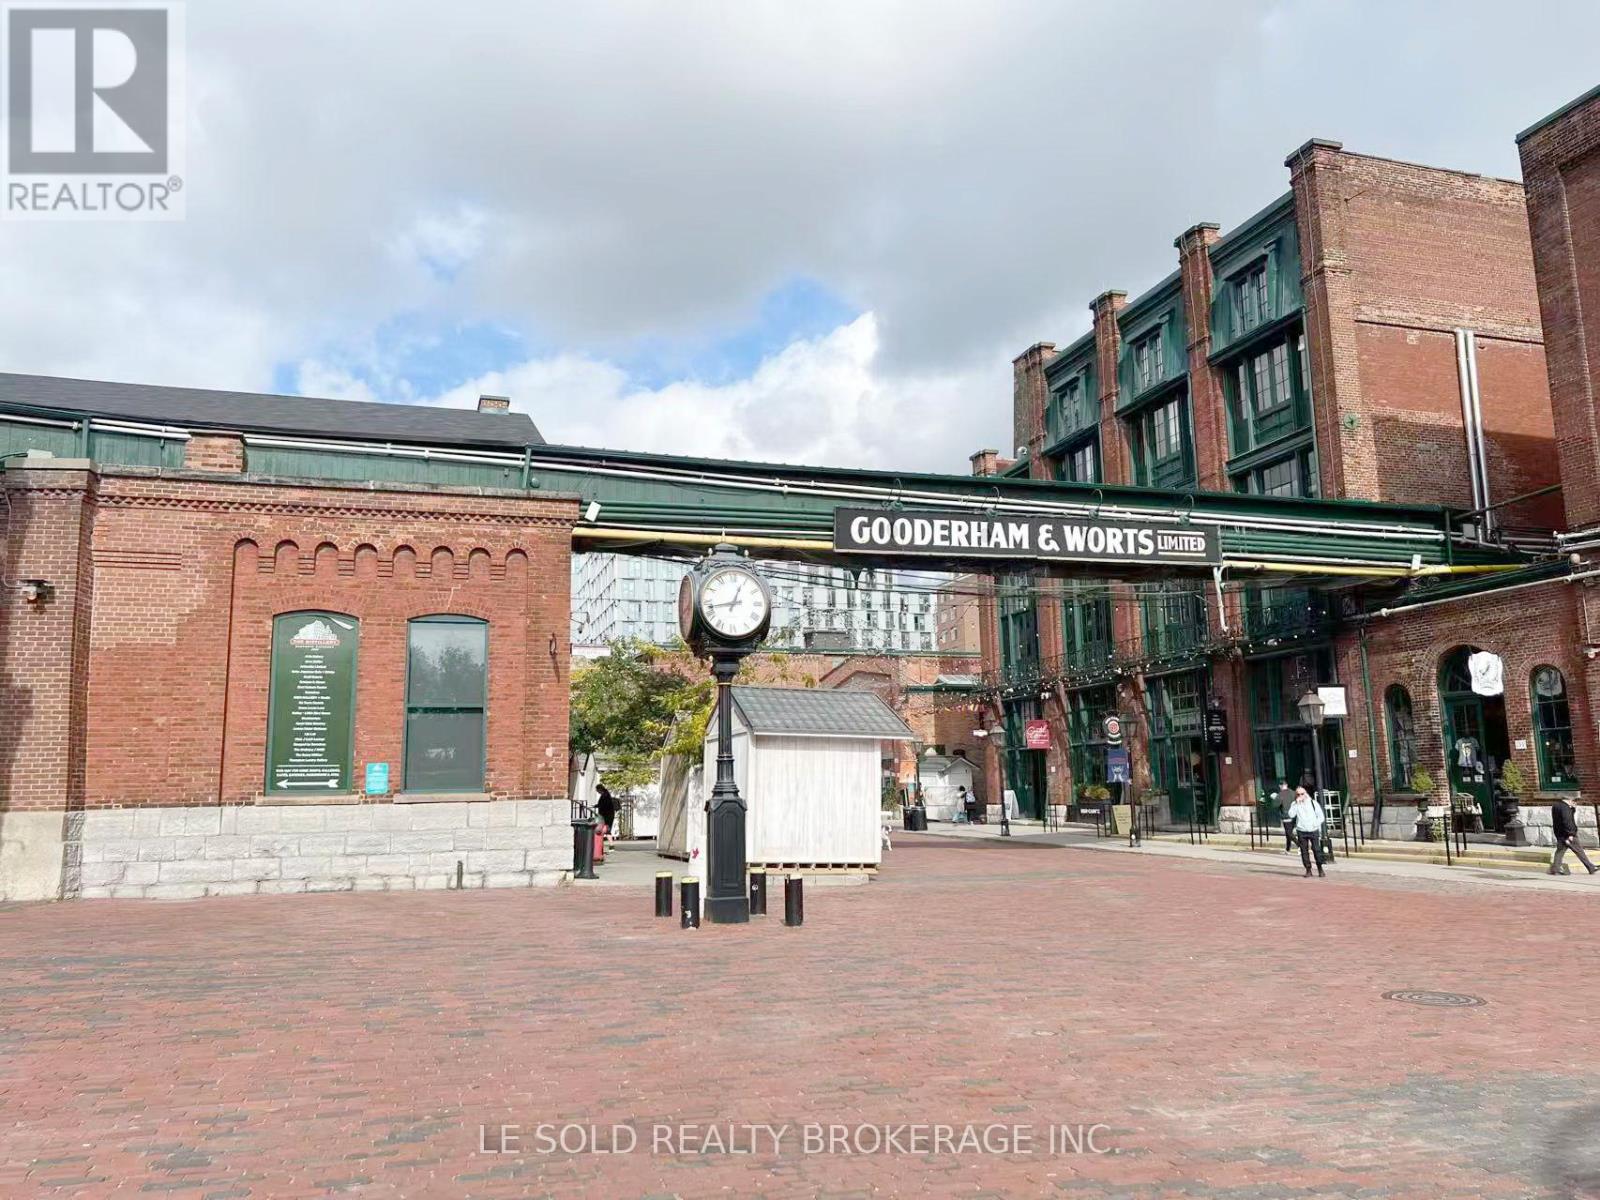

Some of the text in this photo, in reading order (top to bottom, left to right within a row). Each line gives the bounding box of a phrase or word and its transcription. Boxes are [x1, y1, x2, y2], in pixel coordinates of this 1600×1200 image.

[849, 515, 1206, 556] GOODERHAM & WORTS LIMITED
